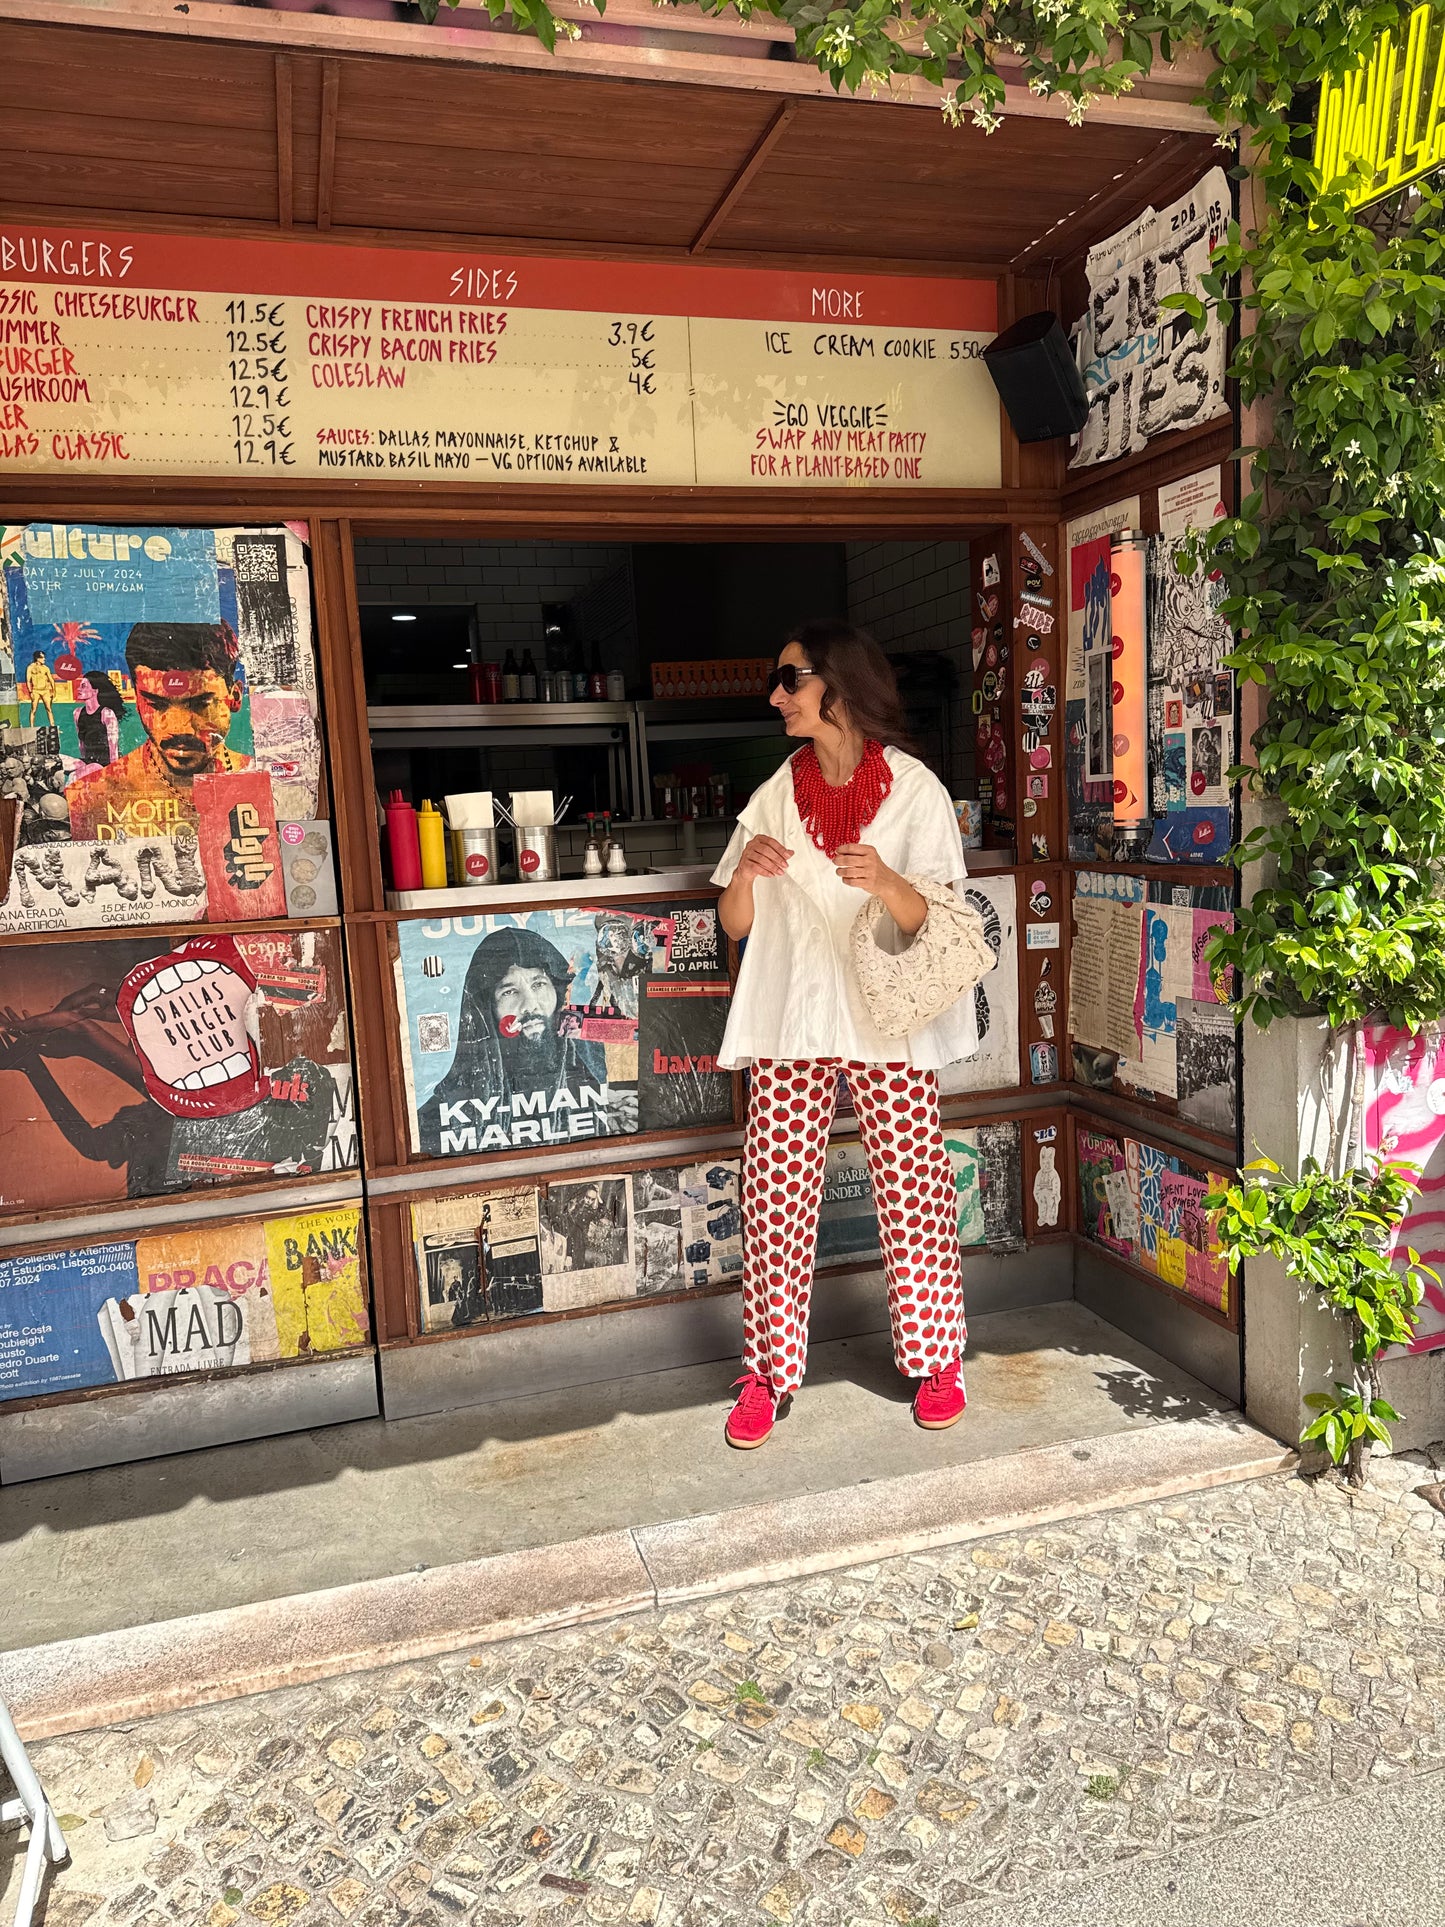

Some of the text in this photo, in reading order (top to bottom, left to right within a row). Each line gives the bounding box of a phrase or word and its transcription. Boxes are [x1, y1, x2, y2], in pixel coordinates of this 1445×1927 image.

[1171, 202, 1196, 231] ZDB
[2, 236, 134, 278] BURGERS
[449, 266, 519, 300] SIDES
[54, 291, 201, 323] CHEESEBURGER
[225, 300, 286, 327] 11.5€
[811, 287, 865, 319] MORE
[306, 304, 656, 347] CRISPY FRENCH FRIES 3.9€
[226, 331, 288, 354] 12.5€
[308, 332, 657, 370] CRISPY BACON FRIES 5€
[765, 331, 794, 355] ICE
[813, 334, 875, 358] CREAM
[884, 338, 937, 360] COOKIE
[228, 358, 289, 382] 12.5€
[311, 361, 657, 396] COLESLAW 4€
[230, 384, 292, 409] 12.9€
[0, 404, 293, 439] ER 12.5€
[786, 403, 874, 429] GO VEGGIE
[52, 432, 131, 461] CLASSIC
[233, 440, 297, 466] 12.9€
[316, 428, 376, 446] SAUCES:
[535, 434, 600, 452] KETCHUP
[609, 436, 621, 453] &
[756, 427, 927, 454] SWAP ANY MEAT PATTY
[389, 451, 649, 474] BASIL MAYO VG OPTIONS AVAILABLE
[751, 454, 777, 477] FOR
[781, 455, 793, 477] A
[894, 457, 923, 480] ONE
[25, 524, 172, 561] ulture
[54, 567, 69, 578] 12
[114, 569, 143, 580] 2024
[85, 582, 145, 594] 10PM/6AM
[106, 799, 186, 823] MOTEL
[8, 909, 26, 920] NA
[27, 908, 48, 919] ERA
[49, 907, 65, 917] DA
[101, 898, 200, 913] 15 DE MAIO MONICA
[101, 912, 151, 923] GAGLIANO
[18, 919, 72, 931] ARTIFICIAL
[688, 960, 719, 971] APRIL
[154, 981, 224, 1025] DALLAS
[164, 1004, 237, 1047] BURGER
[187, 1029, 235, 1062] CLUB
[440, 1083, 610, 1127] KY-MAN
[823, 1184, 863, 1201] UNDER
[298, 1218, 322, 1230] THE
[16, 1250, 66, 1265] Collective
[79, 1243, 134, 1258] Afterhours.
[284, 1225, 358, 1271] BANK
[62, 1257, 96, 1269] Lisboa
[81, 1261, 135, 1276] 2300-0400
[22, 1324, 53, 1336] Costa
[145, 1301, 243, 1357] MAD
[25, 1353, 60, 1365] Duarte
[150, 1363, 191, 1376] ENTRADA
